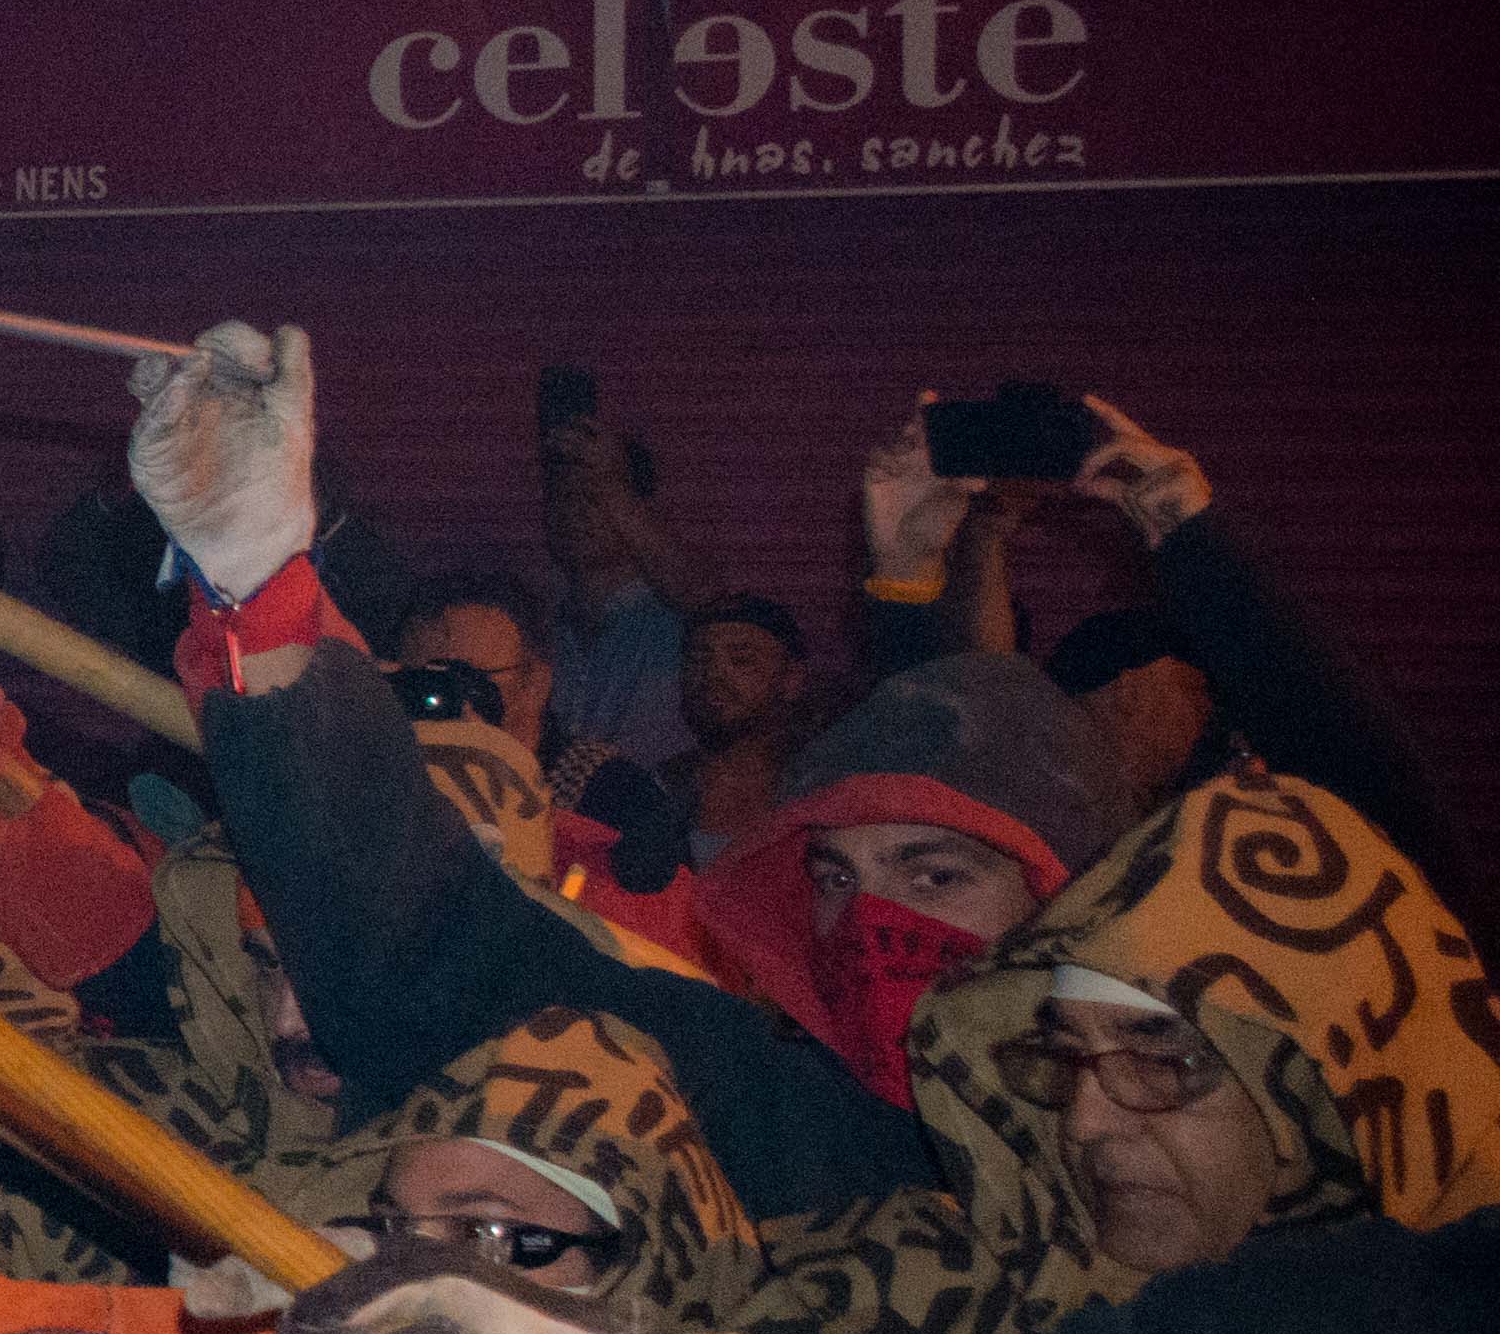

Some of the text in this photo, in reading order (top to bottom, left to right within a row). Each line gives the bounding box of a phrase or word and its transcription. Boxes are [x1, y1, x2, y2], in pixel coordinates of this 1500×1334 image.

[581, 113, 1088, 185] de hnas. sanchez
[16, 164, 109, 202] NENS
